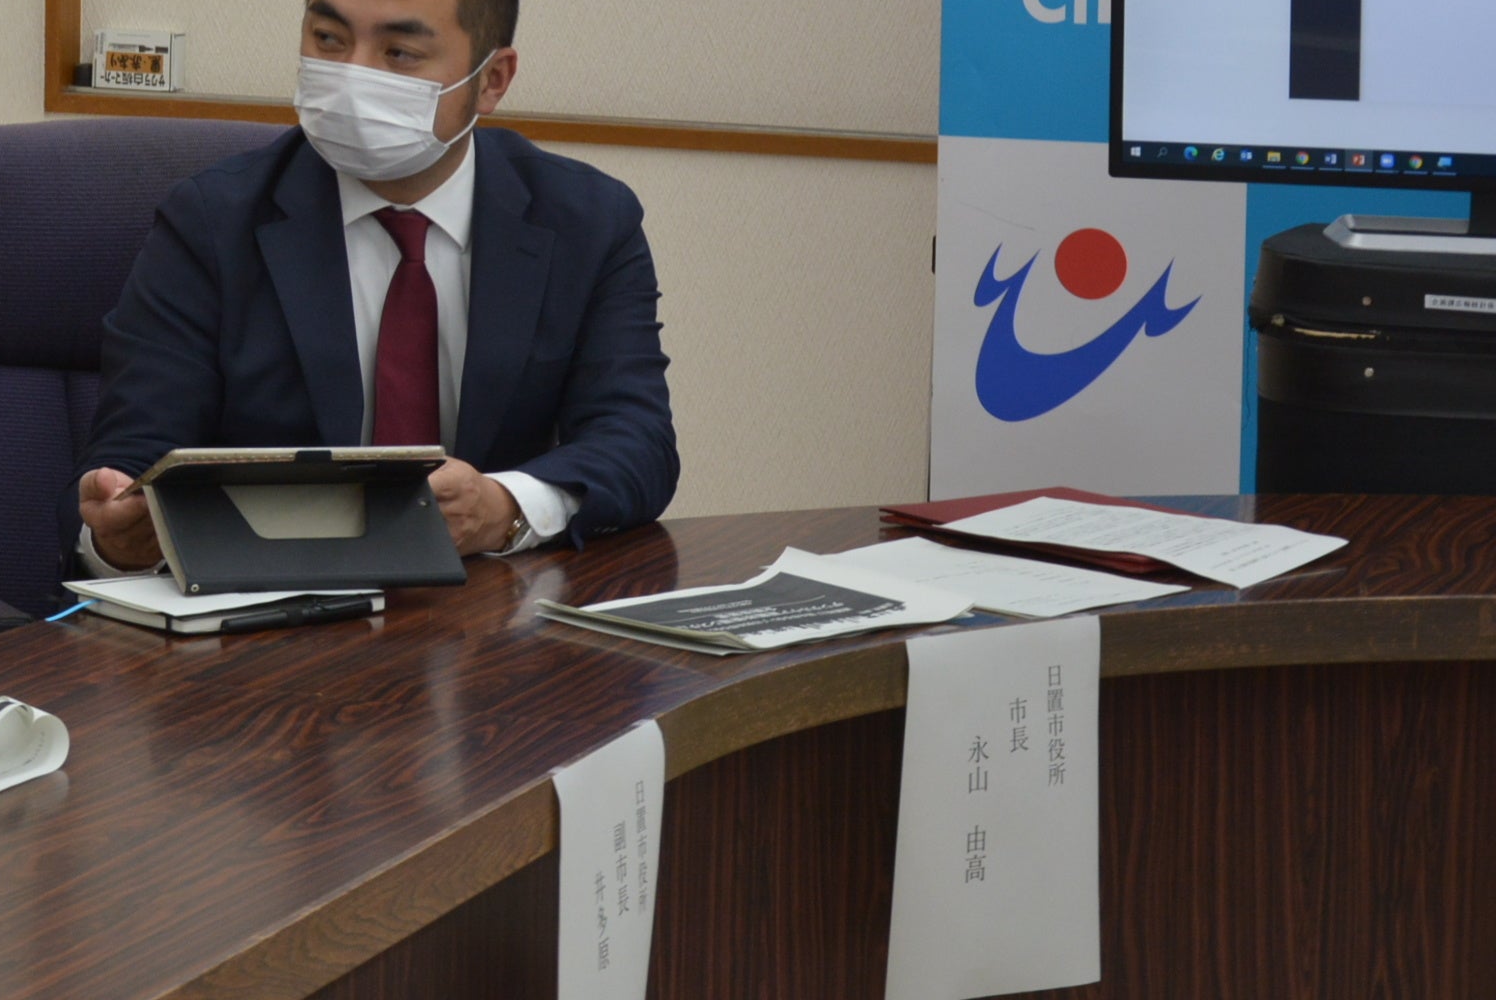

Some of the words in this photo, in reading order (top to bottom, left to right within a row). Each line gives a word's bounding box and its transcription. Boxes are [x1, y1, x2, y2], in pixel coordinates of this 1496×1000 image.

[1009, 697, 1029, 754] 市長
[1047, 664, 1067, 787] 日置市役所
[968, 735, 990, 794] 永山
[964, 825, 988, 884] 由高
